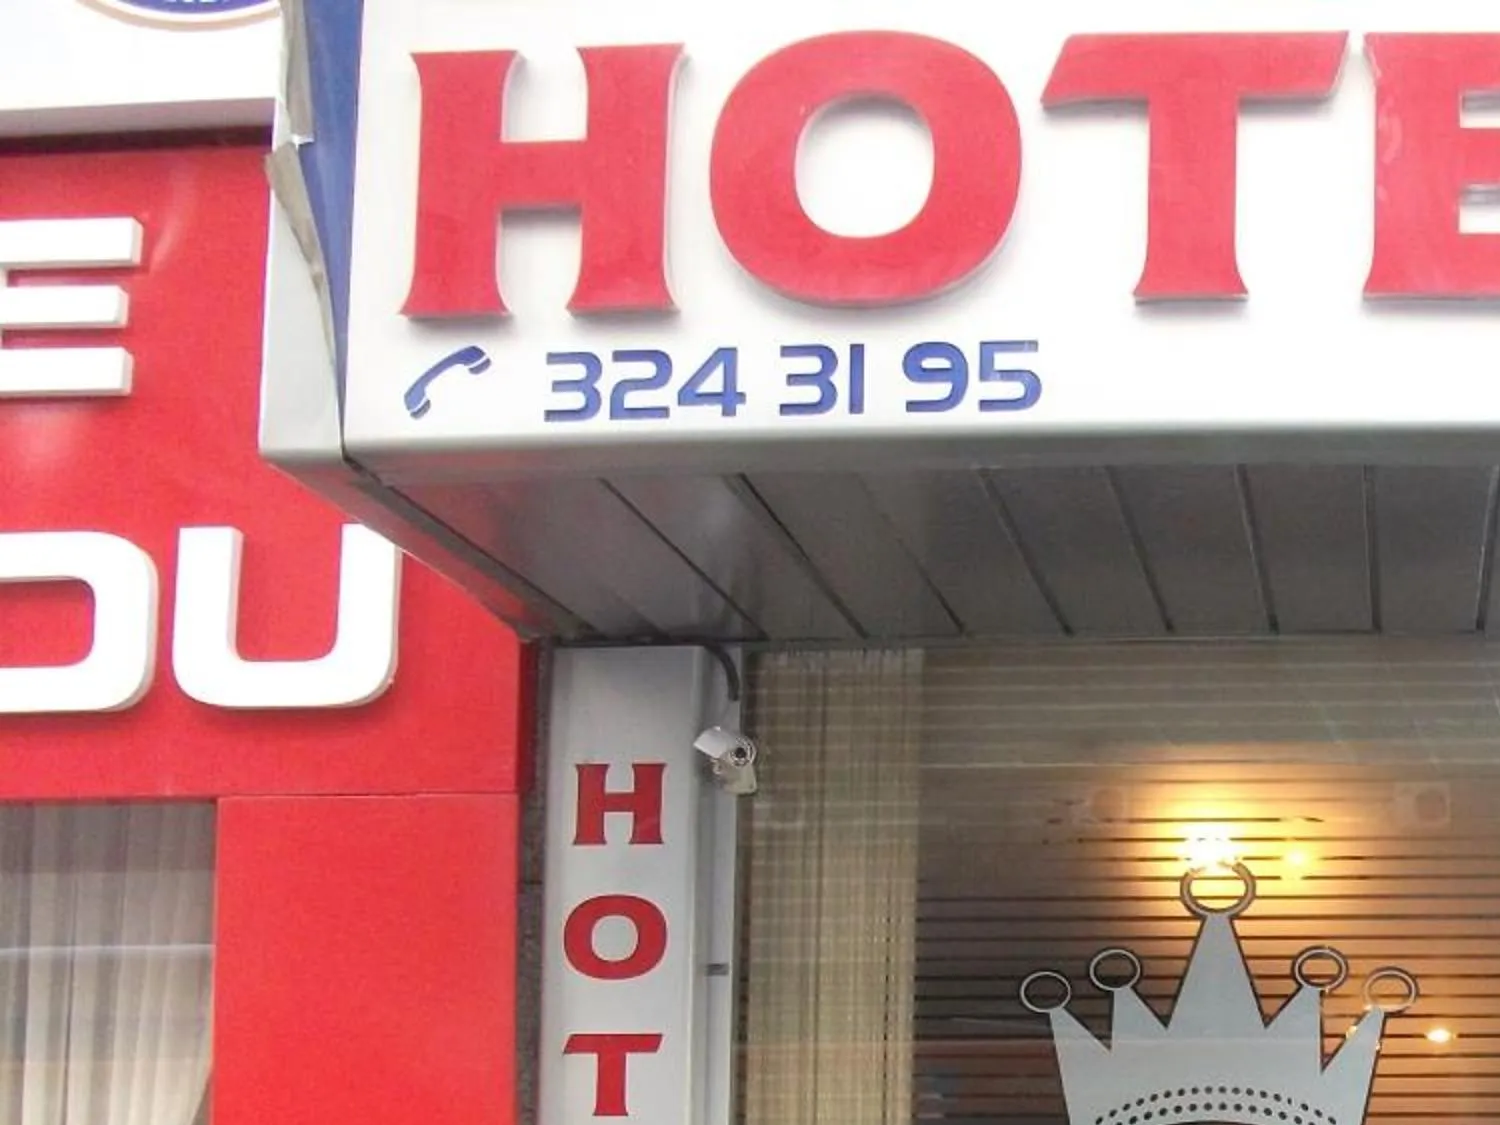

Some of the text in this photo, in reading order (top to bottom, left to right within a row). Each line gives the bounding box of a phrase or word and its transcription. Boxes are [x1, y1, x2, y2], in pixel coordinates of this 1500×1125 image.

[543, 340, 1043, 423] 324 31 95
